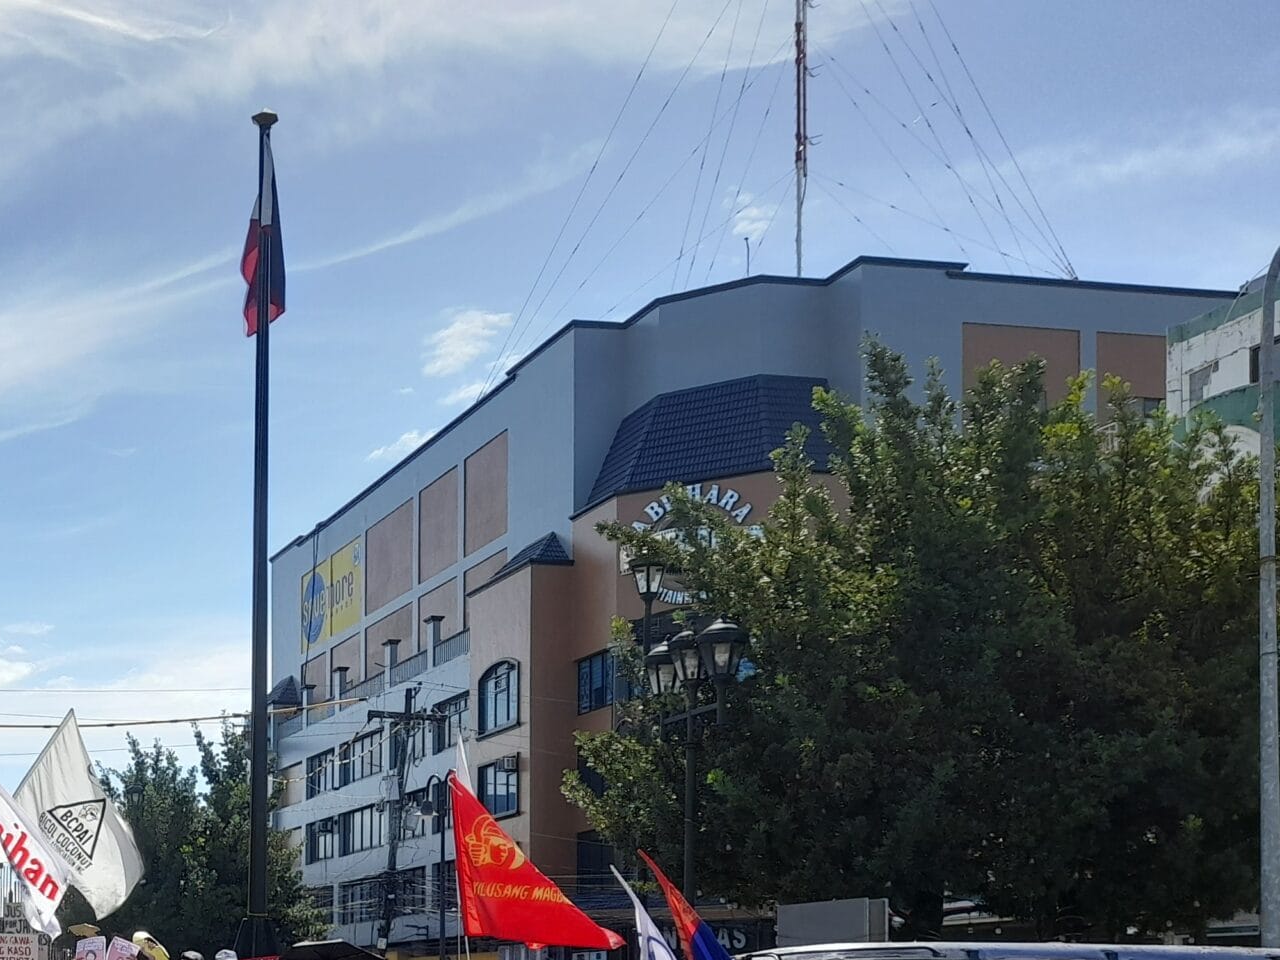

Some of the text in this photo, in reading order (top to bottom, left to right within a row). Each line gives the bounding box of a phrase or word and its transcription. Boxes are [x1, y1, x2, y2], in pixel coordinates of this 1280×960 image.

[39, 811, 58, 839] BICOL
[56, 832, 93, 870] COCONUT
[60, 809, 94, 846] BCPAI
[7, 946, 31, 956] KASO
